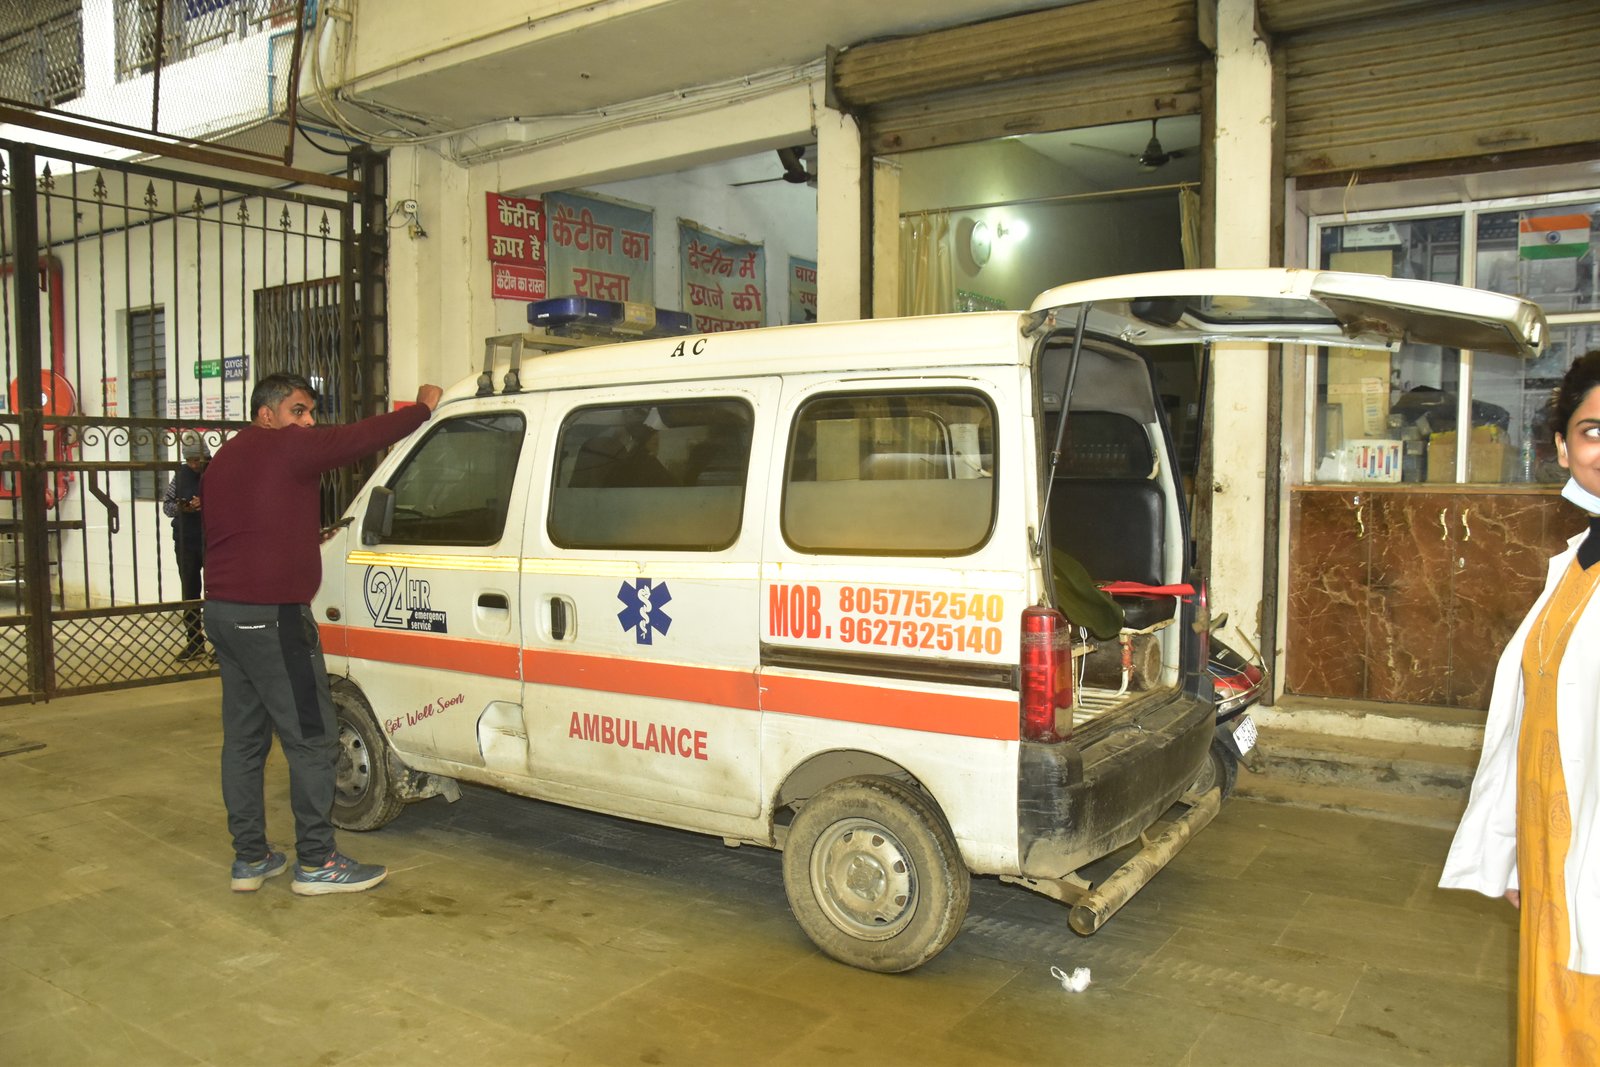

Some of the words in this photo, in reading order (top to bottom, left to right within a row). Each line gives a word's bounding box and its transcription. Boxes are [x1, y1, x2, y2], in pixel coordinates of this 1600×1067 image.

[498, 199, 540, 231] कैंटीन
[492, 235, 524, 259] ऊपर
[529, 235, 541, 261] है
[551, 203, 614, 256] कैंटीन
[621, 228, 650, 263] का
[739, 250, 756, 279] में
[518, 277, 527, 291] का
[528, 278, 545, 293] रास्ता
[572, 267, 630, 302] रास्ता
[687, 282, 724, 310] खाने
[731, 284, 762, 312] की
[408, 579, 431, 611] HR
[411, 620, 432, 631] service
[414, 611, 446, 624] emergency
[769, 584, 831, 639] MOB.
[839, 586, 1004, 622] 8057752540
[839, 616, 1002, 655] 9627325140
[385, 716, 405, 736] Get
[406, 703, 434, 727] Well
[436, 693, 465, 714] Soon
[568, 711, 708, 761] AMBULANCE
